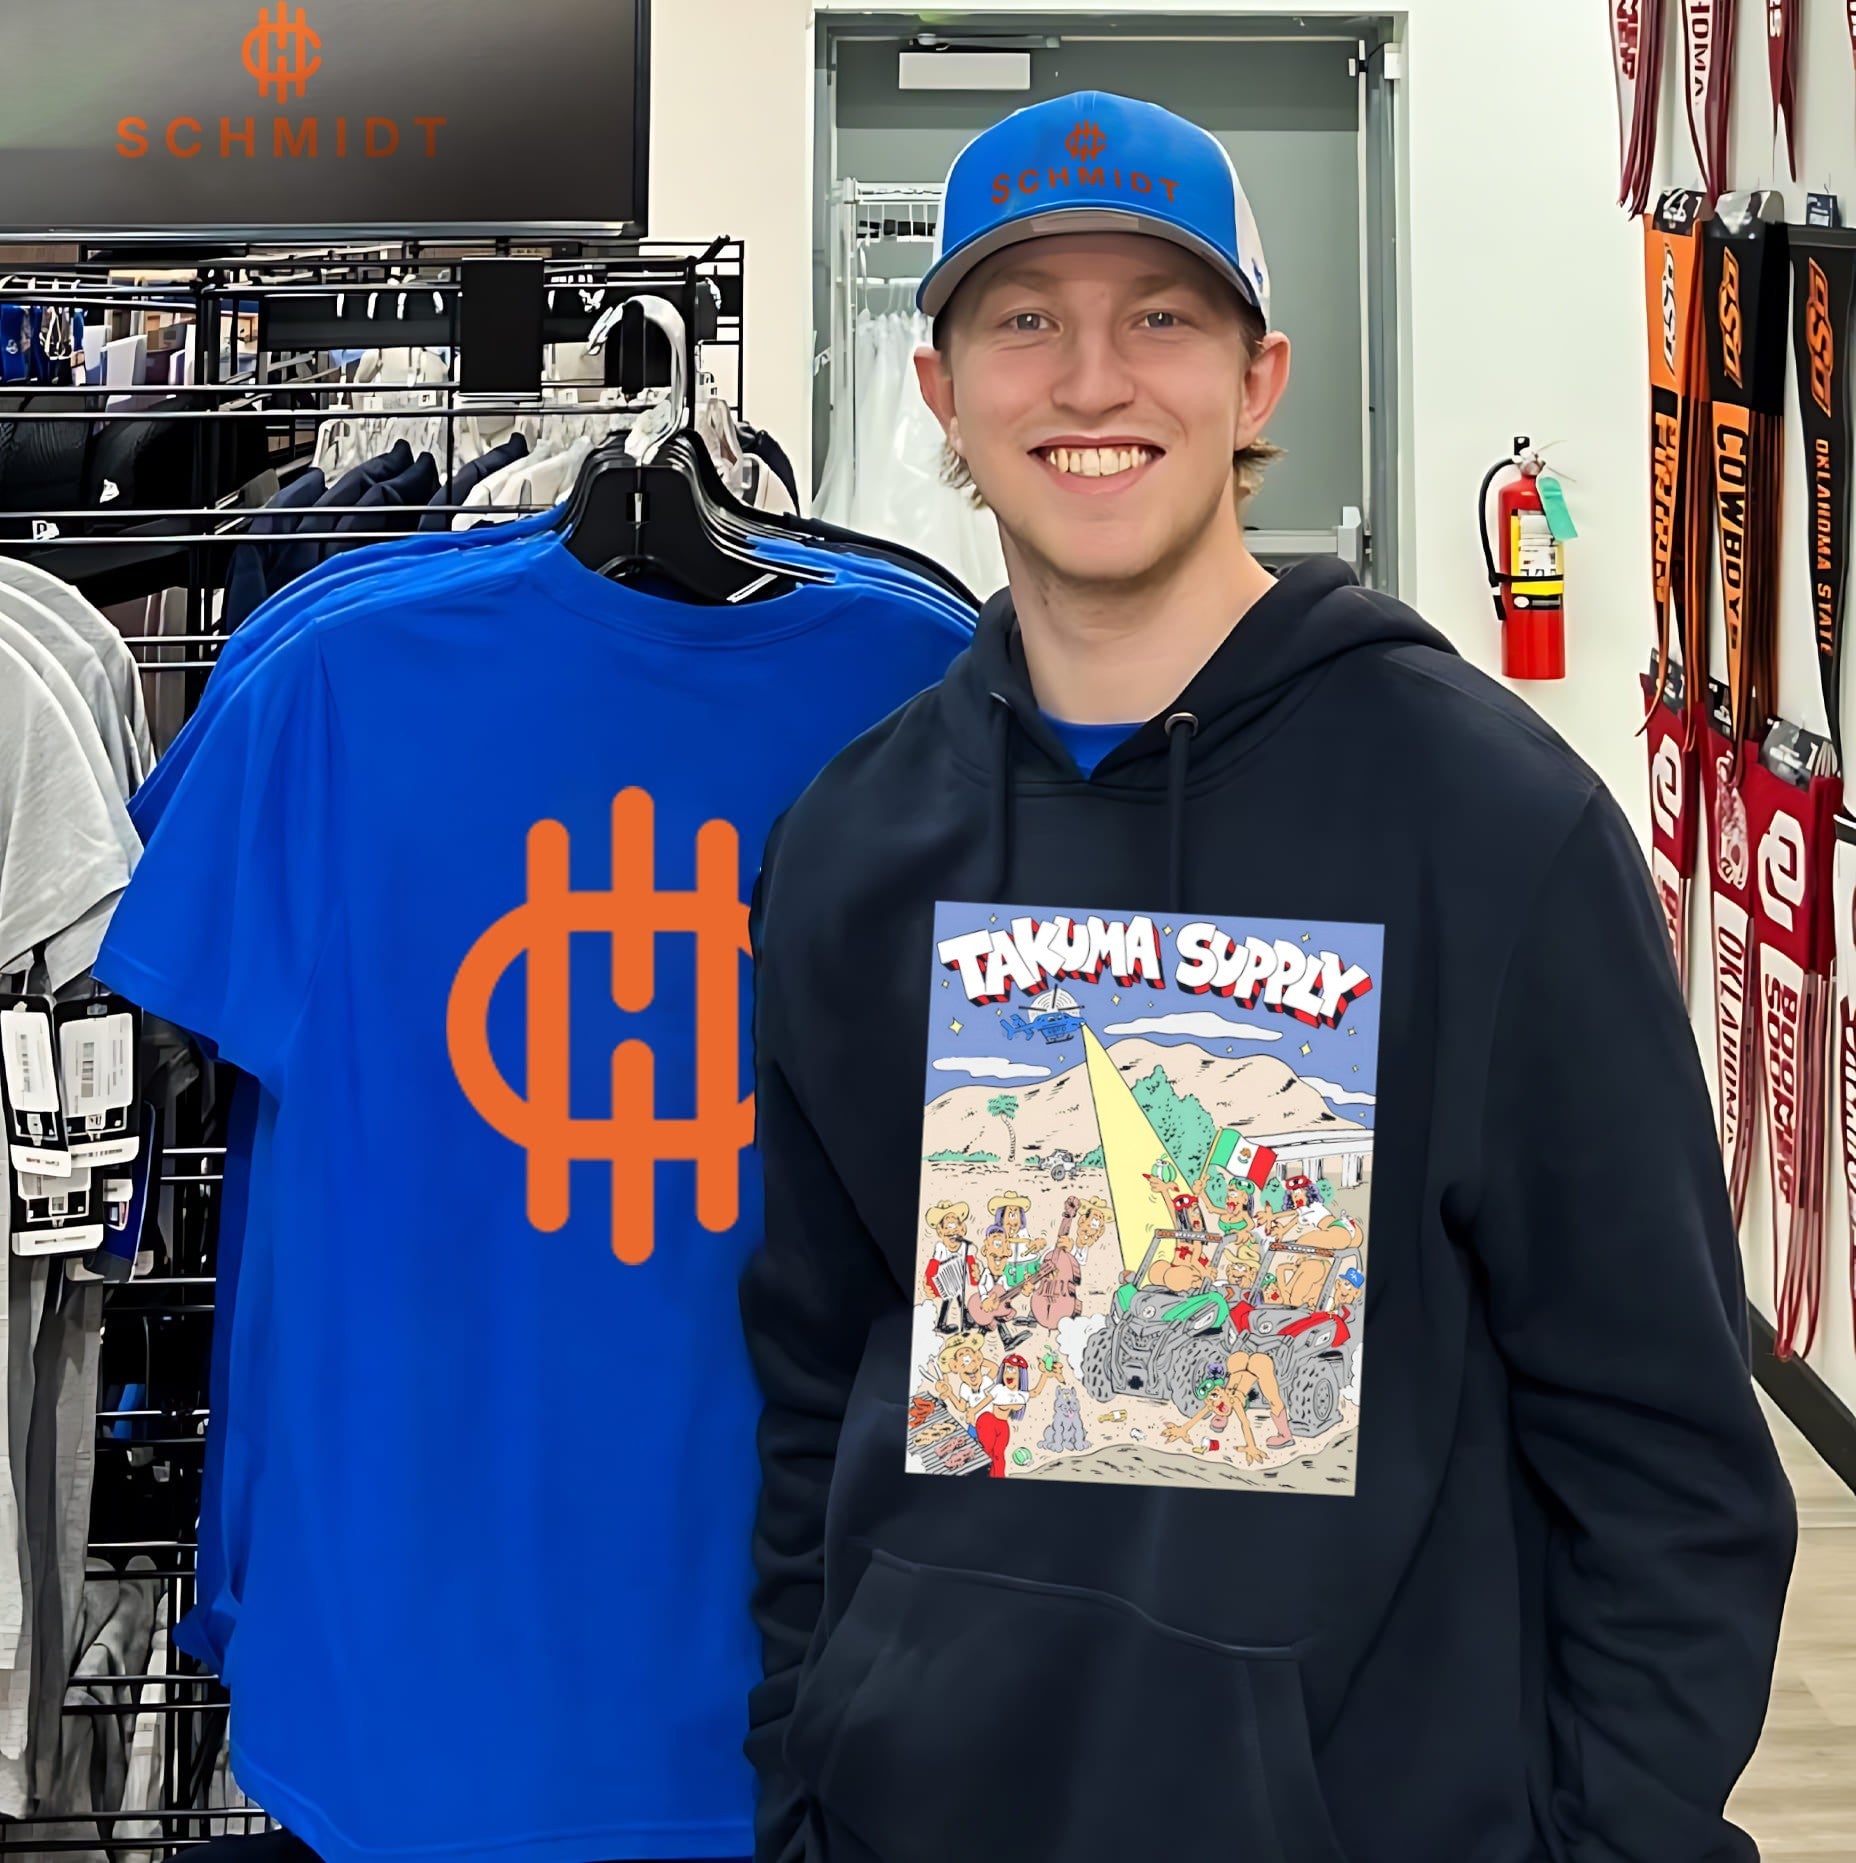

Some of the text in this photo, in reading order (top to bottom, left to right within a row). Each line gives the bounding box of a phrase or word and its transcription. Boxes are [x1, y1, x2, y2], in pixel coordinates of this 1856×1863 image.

[115, 116, 448, 159] SCHMIDT
[991, 166, 1179, 205] SCHMIDT
[1815, 438, 1832, 571] OKLAHOMA
[936, 914, 1374, 1030] TAKUMA SUPPLY
